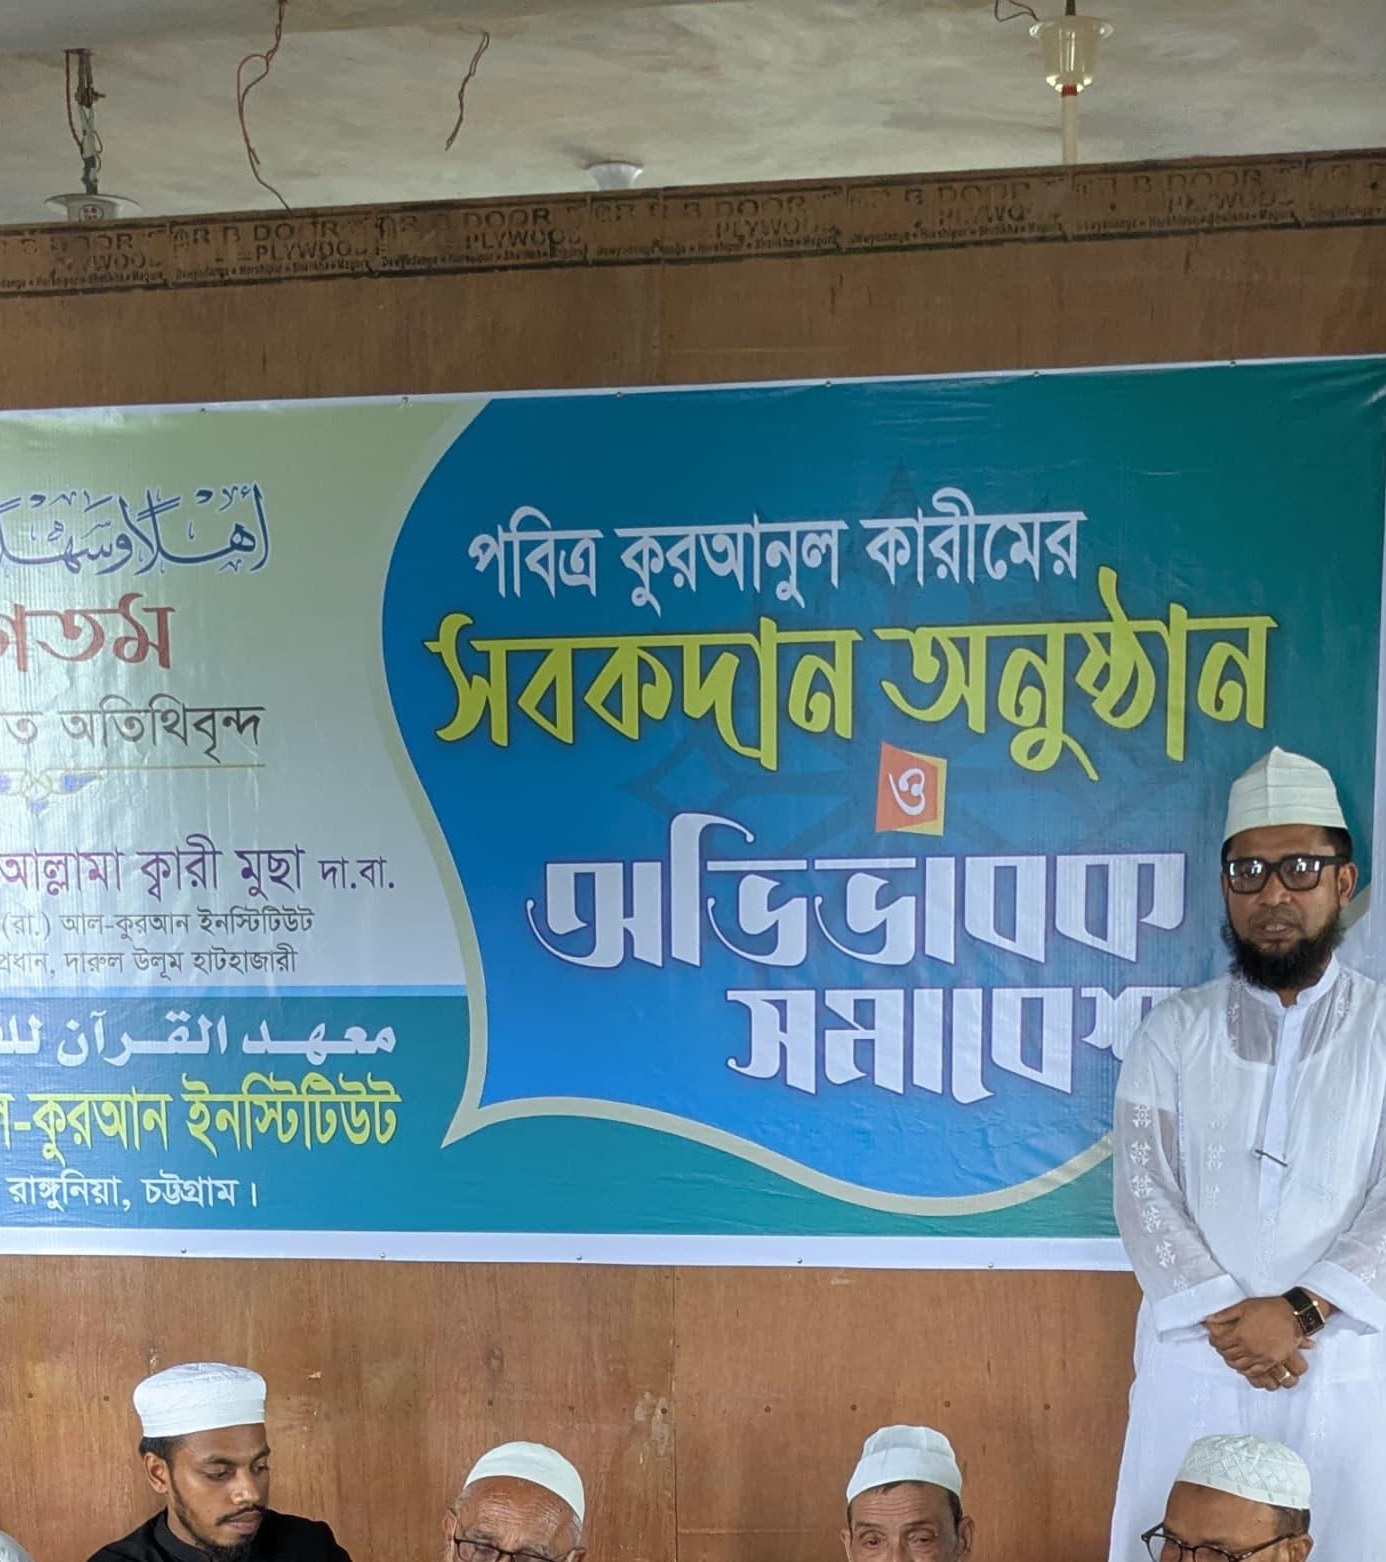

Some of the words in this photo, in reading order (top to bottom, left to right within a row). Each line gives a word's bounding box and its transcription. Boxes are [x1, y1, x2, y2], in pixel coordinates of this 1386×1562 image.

[468, 505, 605, 600] পবিত্র
[613, 511, 850, 618] কুরআনুল
[858, 486, 1089, 588] কারীমের
[424, 612, 864, 772] সবকদান
[872, 565, 1280, 782] অনুষ্ঠান
[59, 693, 267, 764] অতিথিবৃন্দ
[888, 766, 926, 816] ও
[135, 833, 223, 902] ক্বারী
[234, 843, 306, 900] মুছা
[525, 810, 1188, 969] অভিভাবক
[59, 911, 191, 941] আল-কুরআন
[197, 904, 316, 936] ইনস্টিটিউট
[65, 950, 124, 974] দারুল
[190, 942, 299, 975] হাটহাজারী
[55, 1008, 229, 1067] القرآن
[241, 1018, 397, 1066] معهد
[180, 1071, 403, 1159] ইনস্টিটিউট
